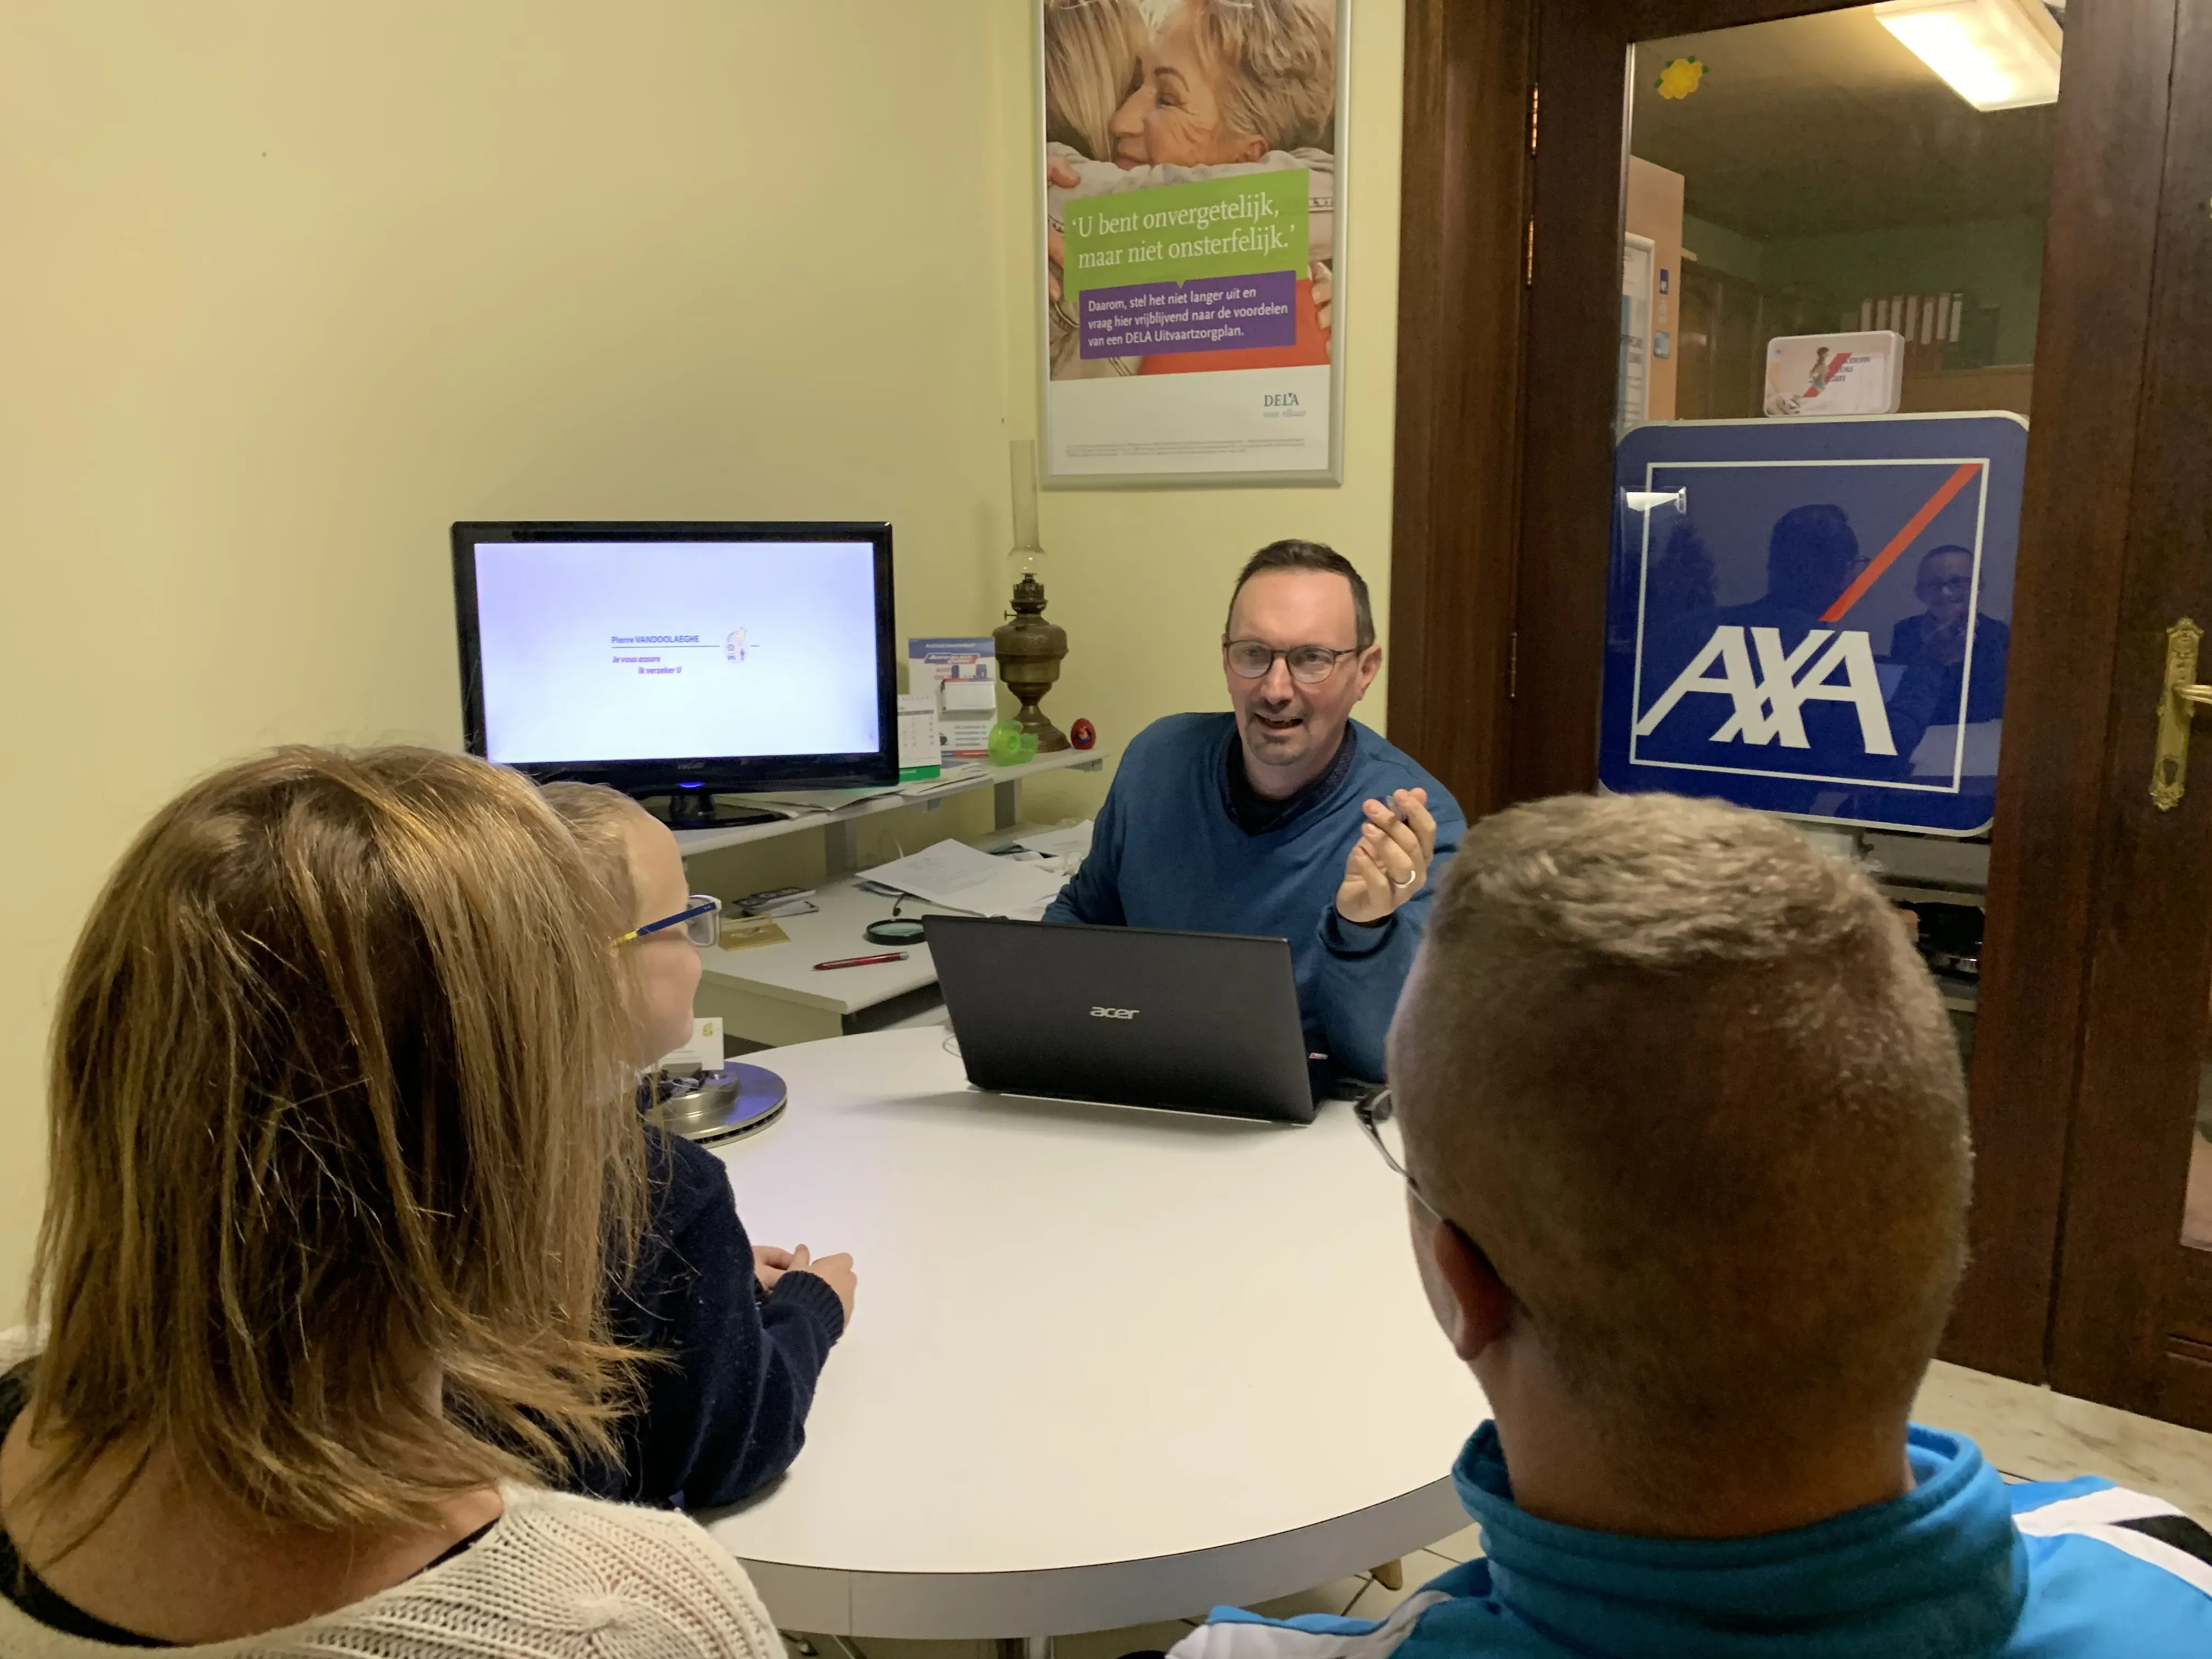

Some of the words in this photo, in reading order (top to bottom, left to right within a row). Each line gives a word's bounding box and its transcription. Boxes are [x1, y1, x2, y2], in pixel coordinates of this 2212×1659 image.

[1099, 213, 1138, 235] bent
[1143, 192, 1279, 230] onvergetelijk,
[1078, 249, 1122, 268] maar
[1128, 240, 1163, 263] niet
[1088, 300, 1127, 312] Daarom,
[1129, 294, 1147, 308] stel
[1149, 294, 1165, 307] het
[1167, 291, 1187, 304] niet
[1190, 290, 1223, 305] langer
[1226, 287, 1240, 300] uit
[1243, 288, 1256, 298] en
[1088, 319, 1113, 332] vraag
[1114, 314, 1132, 328] hier
[1135, 309, 1188, 328] vrijblijvend
[1192, 310, 1214, 320] naar
[1217, 306, 1231, 319] de
[1234, 303, 1288, 318] voordelen
[1088, 337, 1104, 347] van
[1106, 335, 1123, 346] een
[1125, 331, 1152, 344] DELA
[1155, 324, 1244, 342] Uitvaartzorgplan.
[1263, 393, 1299, 407] DELA
[1635, 625, 1898, 755] AXA
[1090, 1006, 1140, 1019] acer
